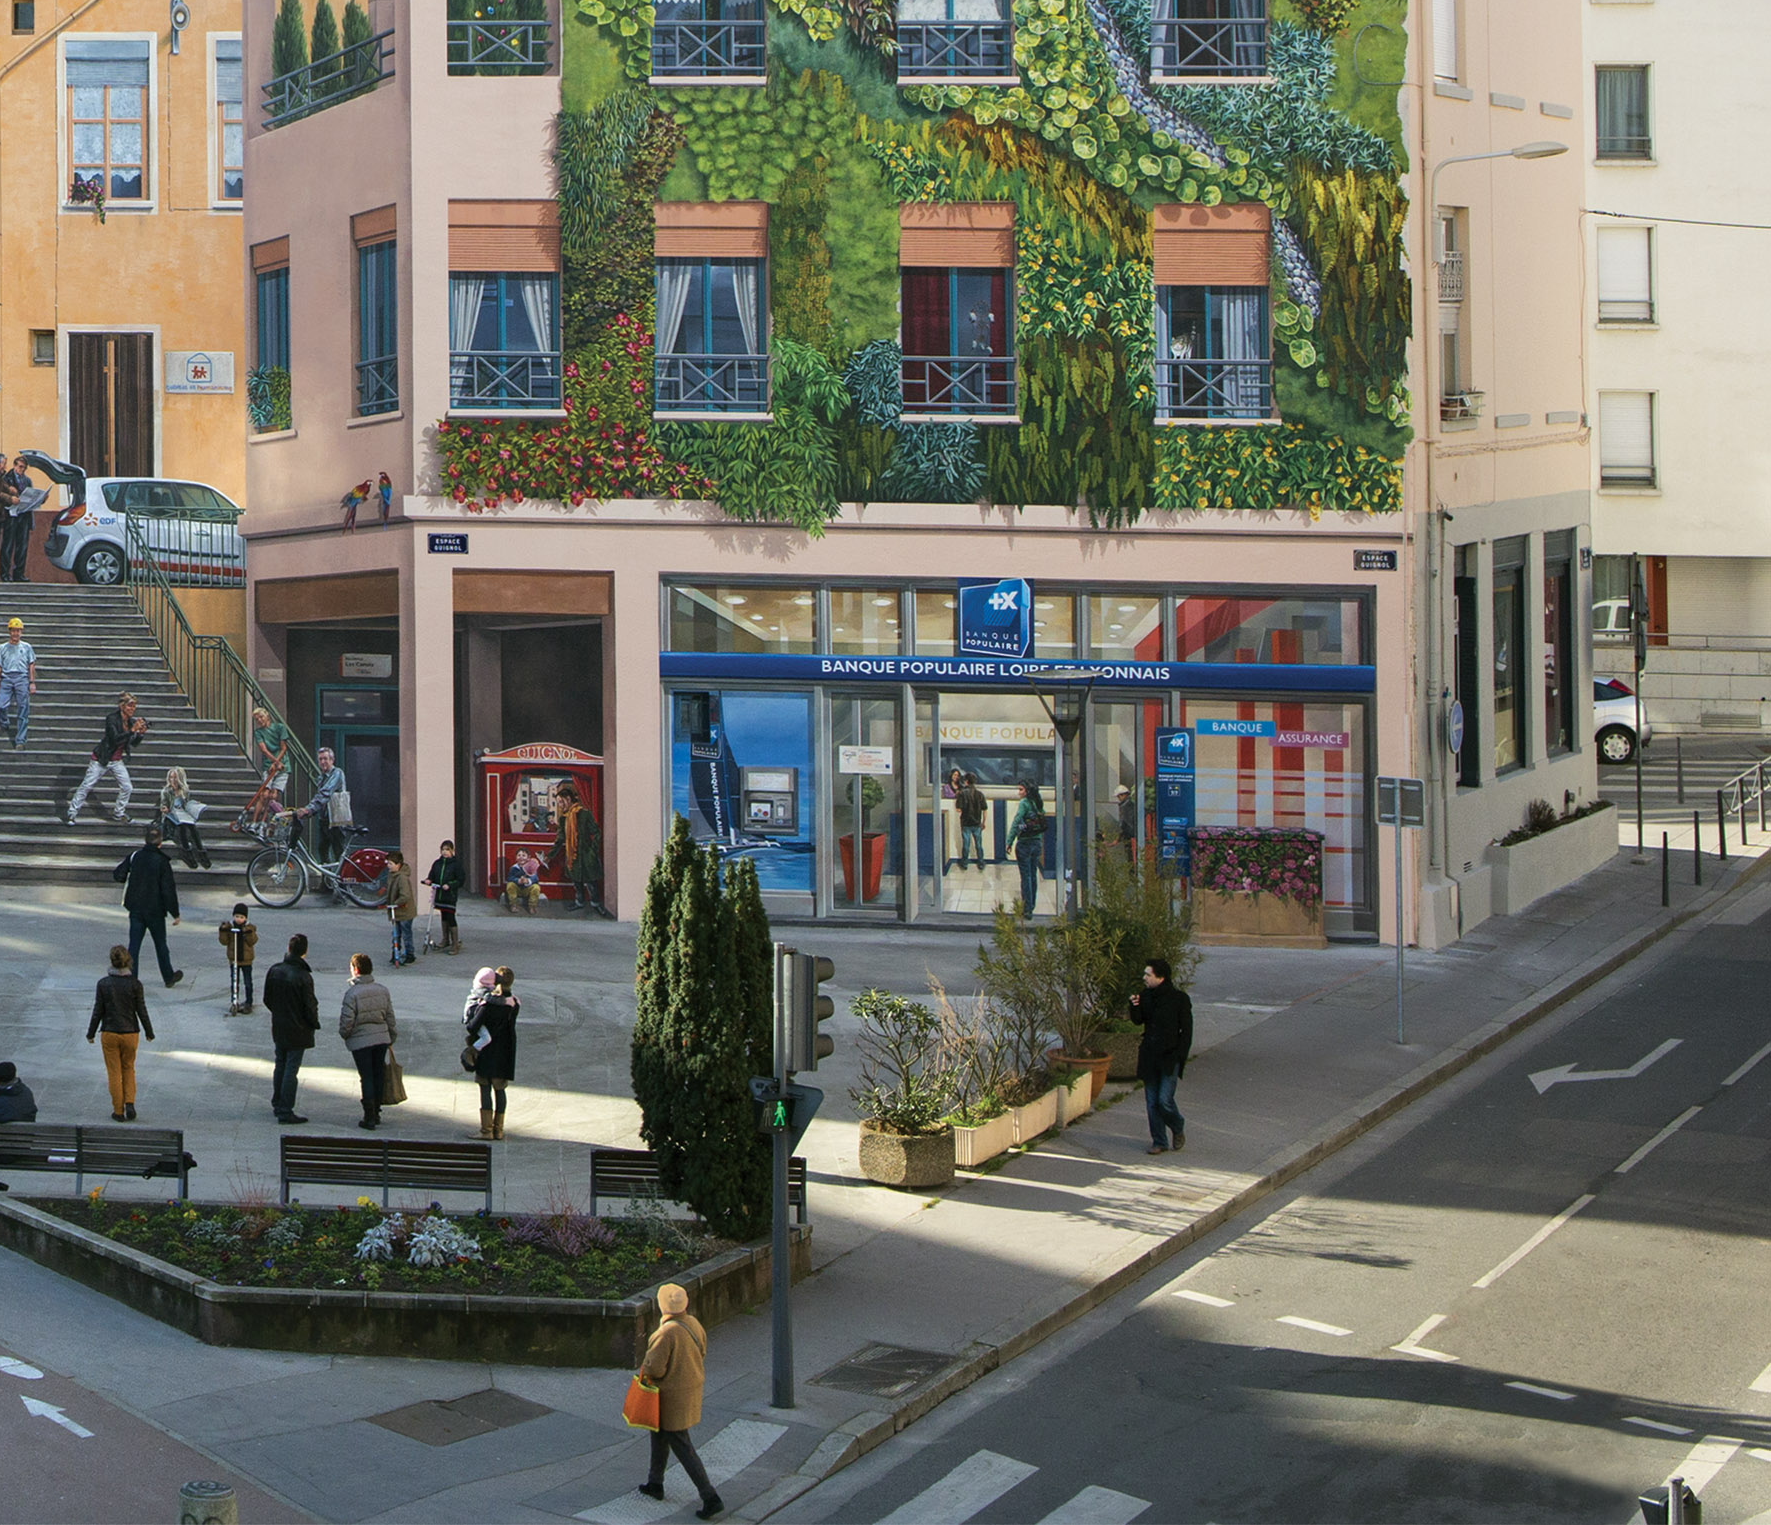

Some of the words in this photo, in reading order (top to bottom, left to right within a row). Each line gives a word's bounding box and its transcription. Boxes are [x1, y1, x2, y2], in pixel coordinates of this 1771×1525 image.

[966, 630, 1019, 641] BANQUE
[966, 639, 1019, 651] POPULAIRE
[821, 659, 895, 675] BANQUE
[901, 661, 995, 676] POPULAIRE
[1211, 722, 1263, 733] BANQUE
[1278, 733, 1343, 745] ASSURANCE
[516, 745, 578, 760] GUIGNOL
[710, 762, 719, 794] BANQUE
